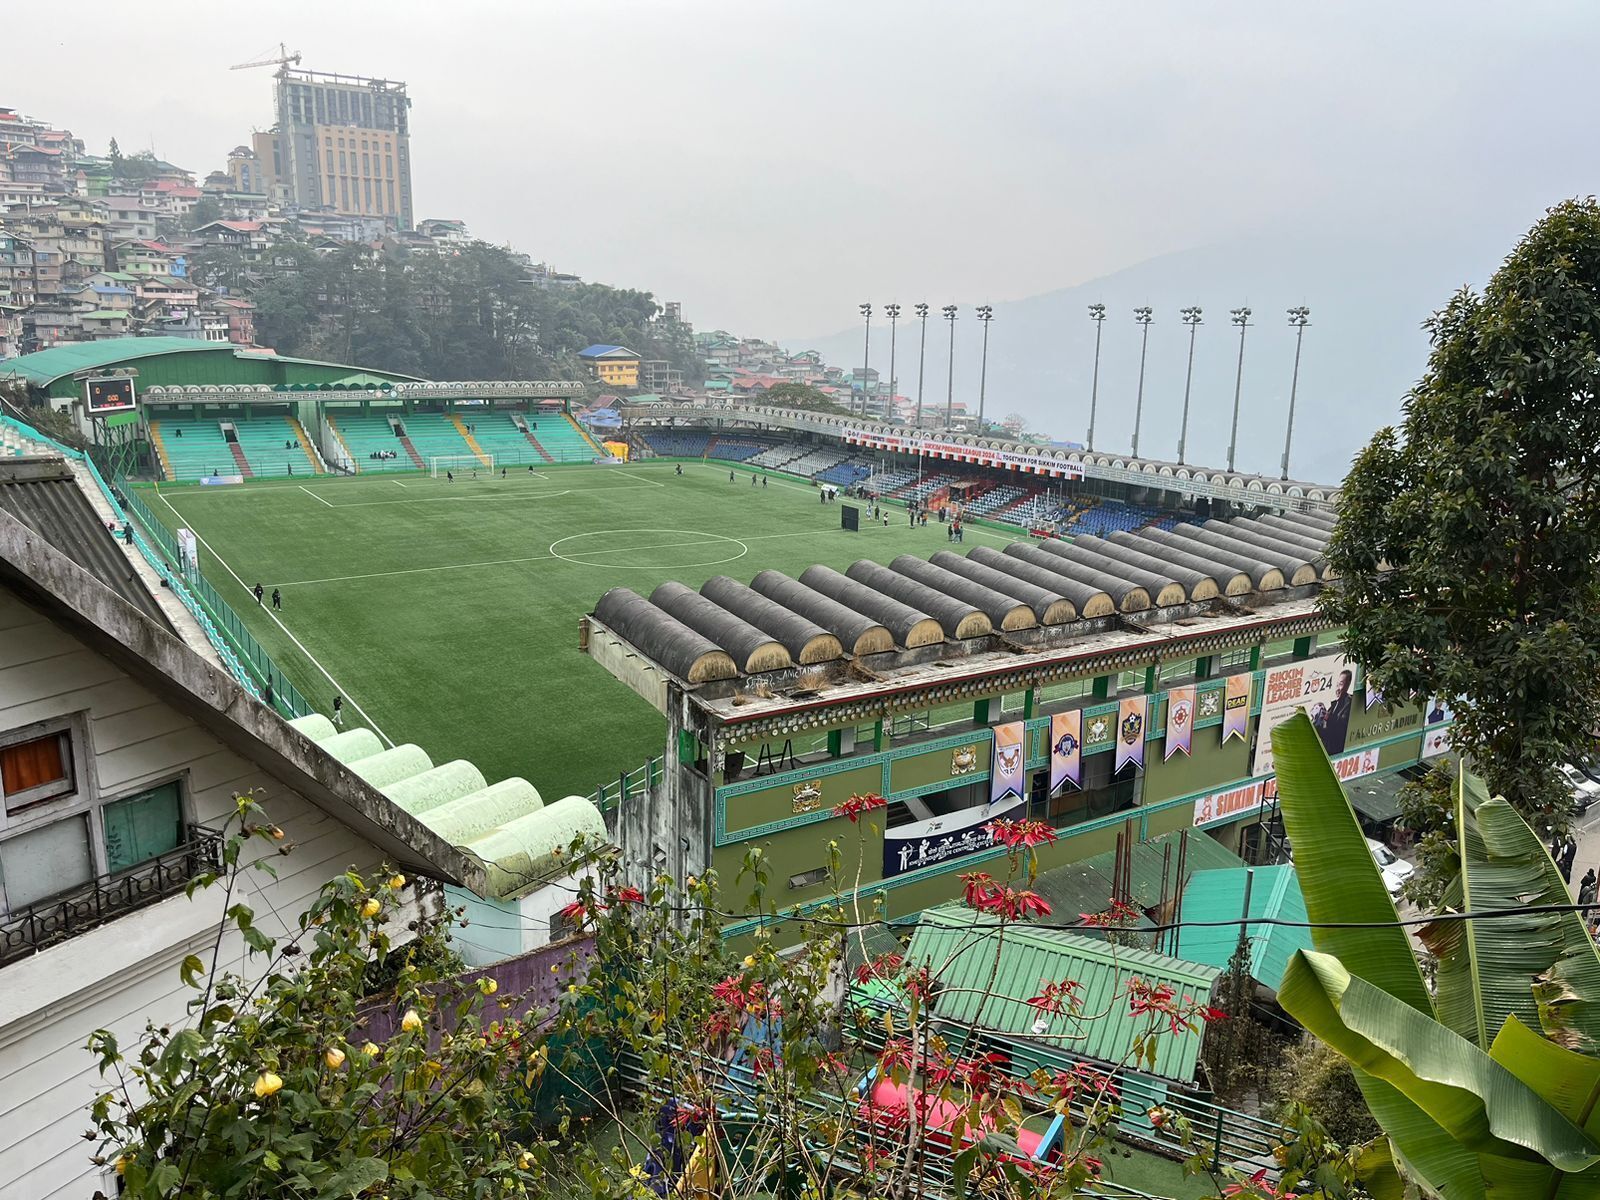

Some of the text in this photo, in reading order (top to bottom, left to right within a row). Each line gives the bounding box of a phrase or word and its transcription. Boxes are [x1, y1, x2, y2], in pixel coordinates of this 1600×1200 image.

[963, 448, 982, 457] LEAGUE
[982, 451, 996, 459] 2024
[1002, 454, 1027, 463] TOGETHER
[1038, 459, 1055, 468] SIKKIM
[1056, 462, 1083, 472] FOOTBALL
[1269, 667, 1304, 683] SIKKIM
[1268, 677, 1333, 696] PREMIER 2024
[1266, 688, 1301, 705] LEAGUE
[1384, 714, 1418, 732] STADIUM
[1216, 757, 1359, 816] SIKKIM PRE 2024
